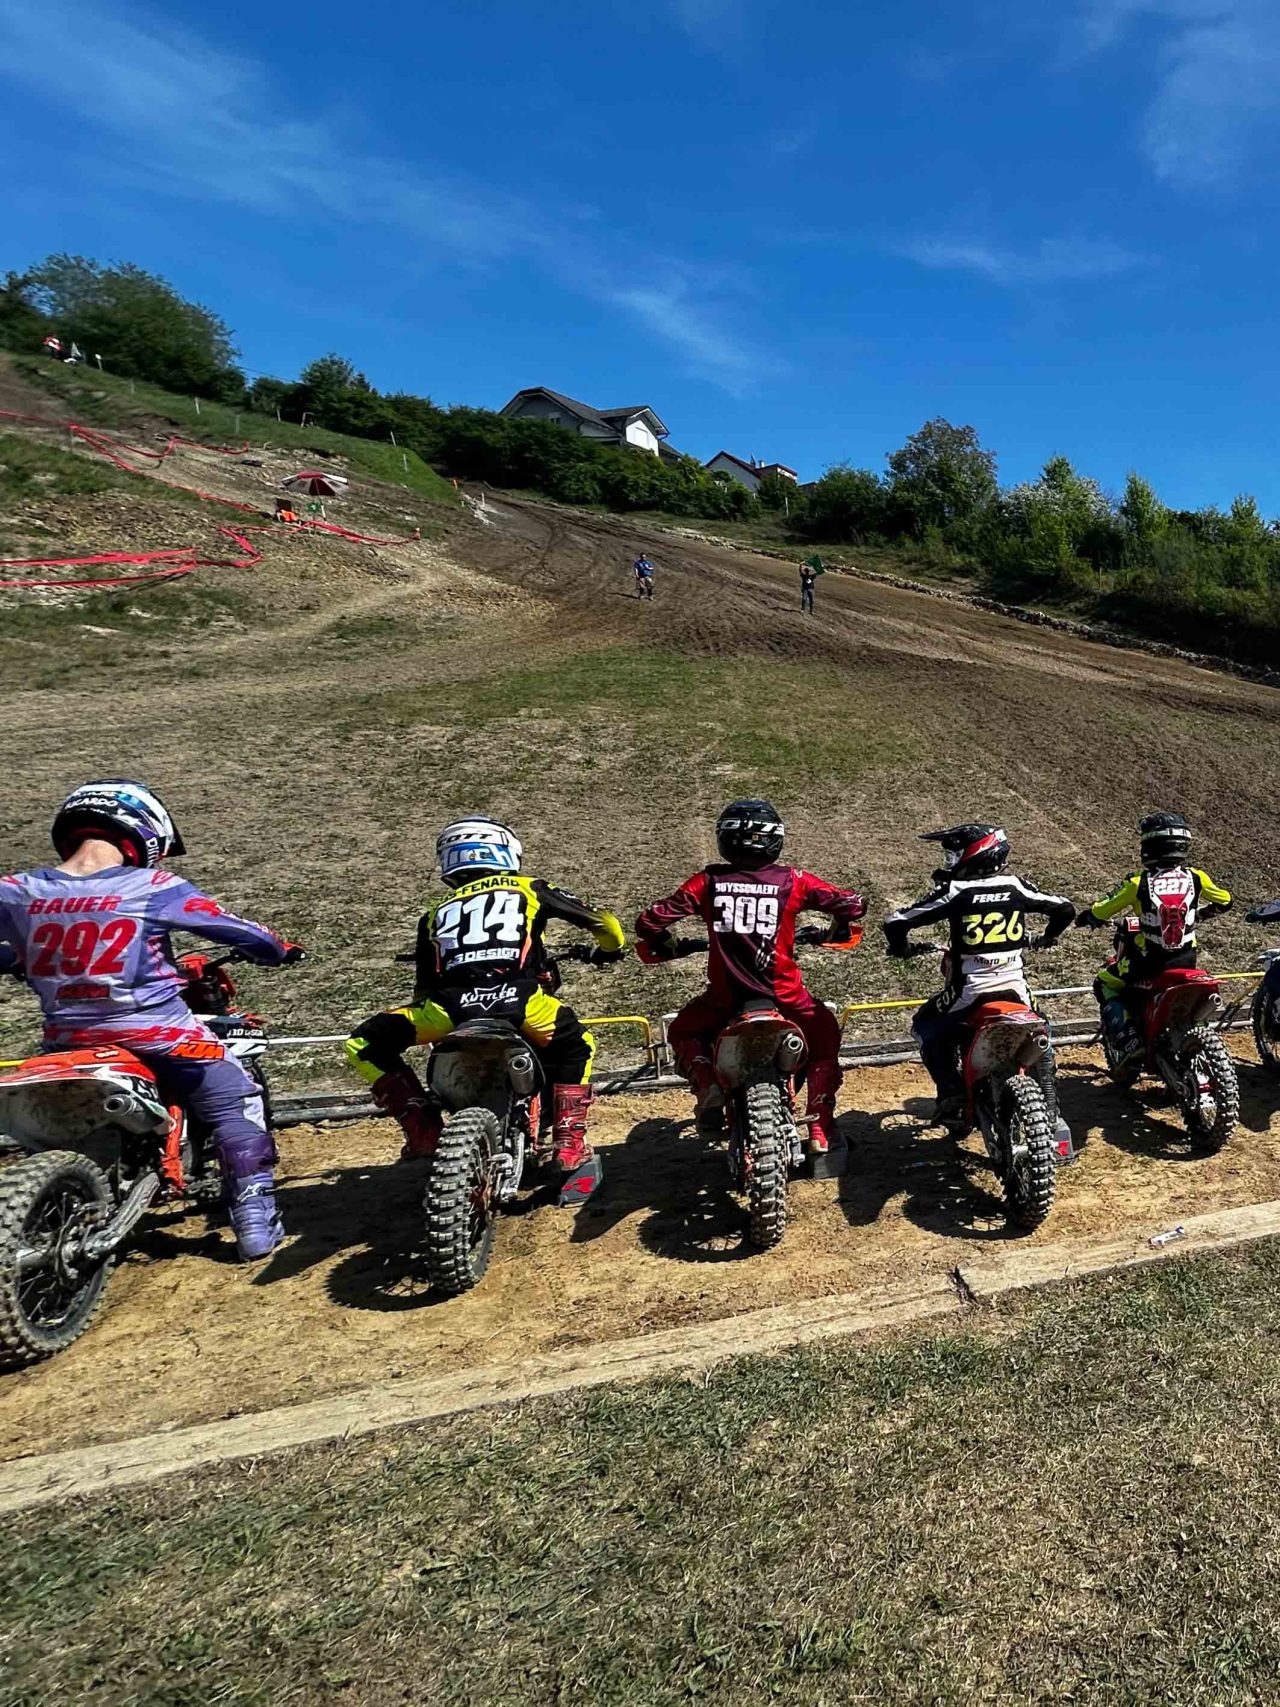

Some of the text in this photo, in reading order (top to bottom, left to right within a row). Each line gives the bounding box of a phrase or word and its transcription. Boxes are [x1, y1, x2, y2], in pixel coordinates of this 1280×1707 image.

[28, 895, 122, 915] BAUER
[1153, 879, 1191, 895] 227
[436, 890, 524, 950] 214
[713, 895, 779, 935] 309
[961, 910, 1023, 946] 326
[31, 918, 137, 977] 292
[171, 1039, 224, 1059] KTM
